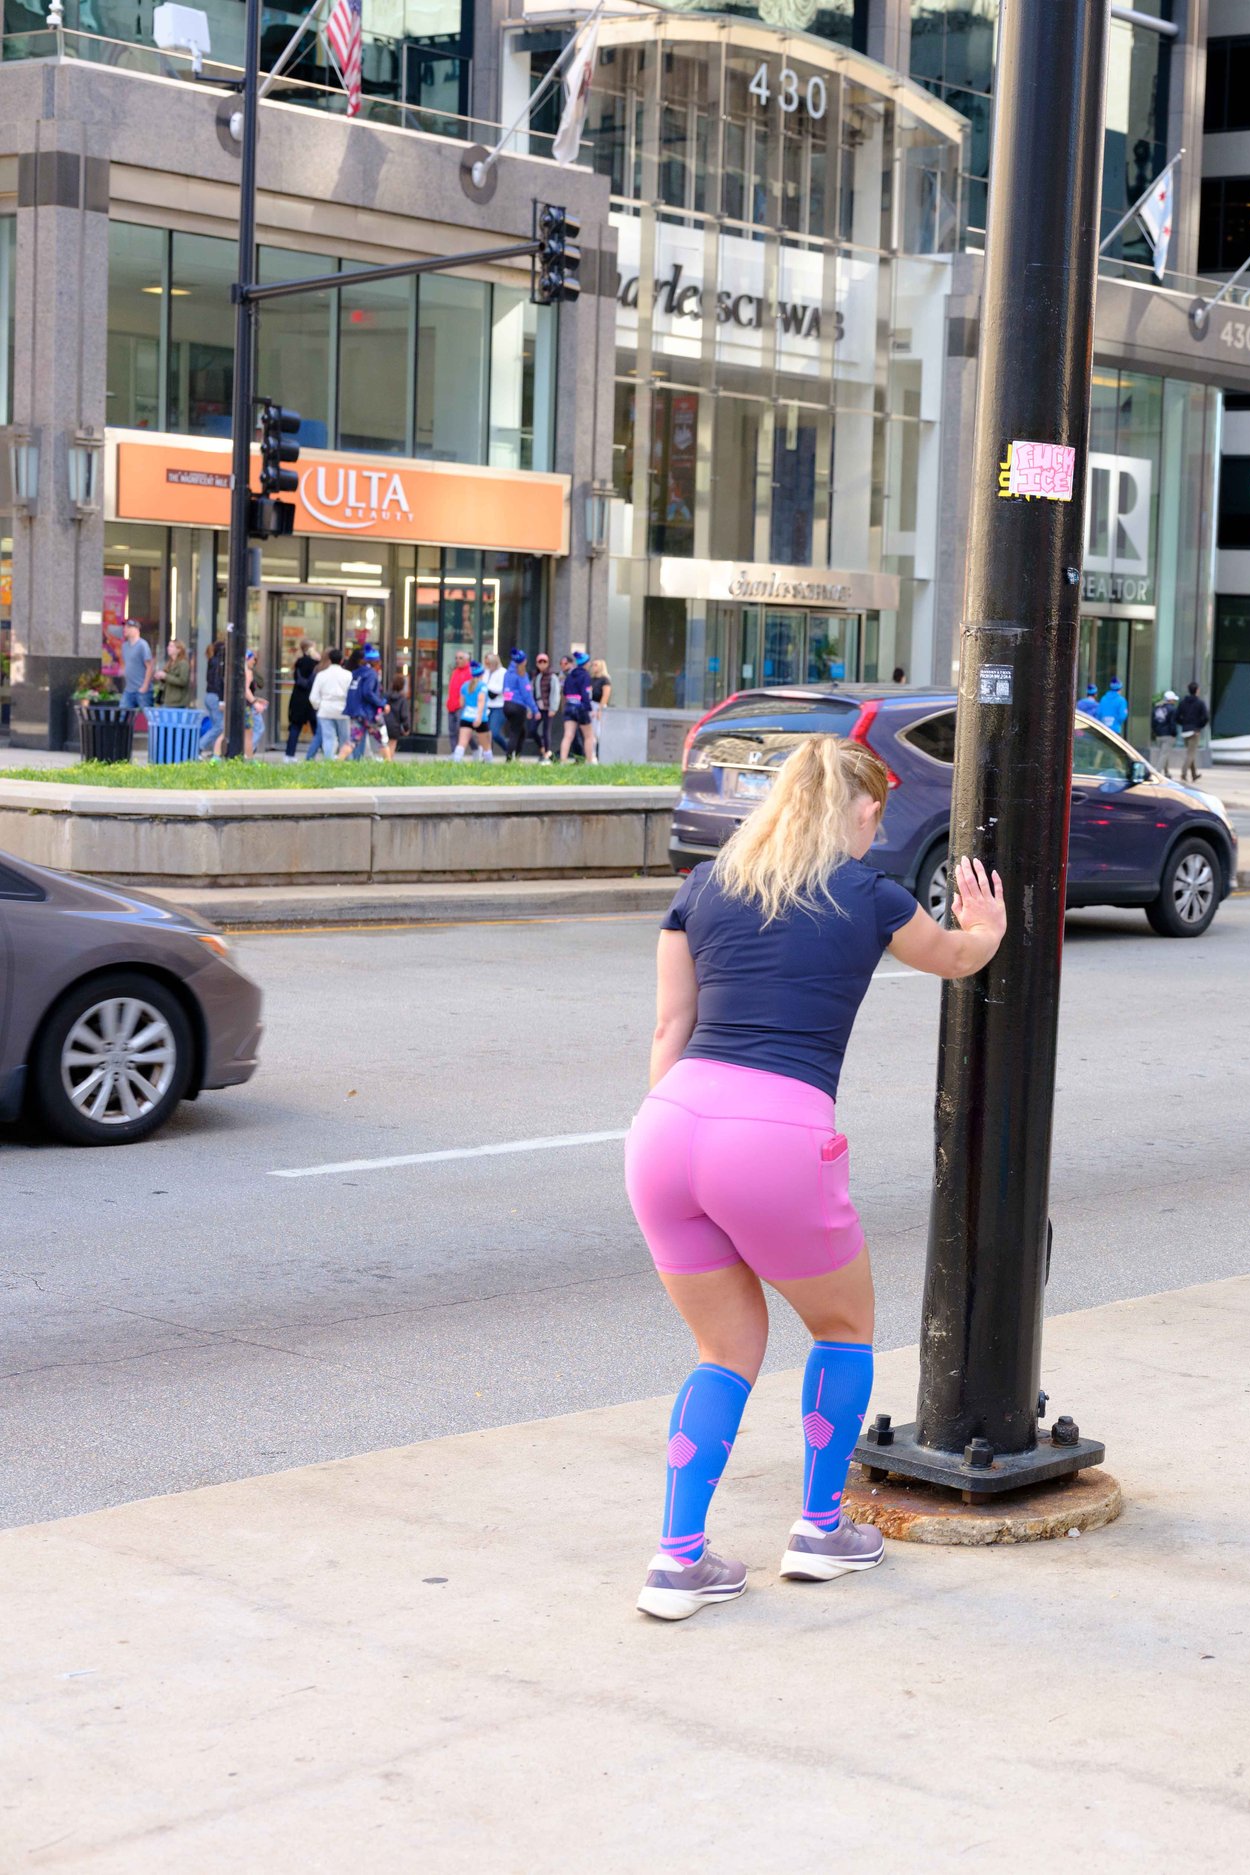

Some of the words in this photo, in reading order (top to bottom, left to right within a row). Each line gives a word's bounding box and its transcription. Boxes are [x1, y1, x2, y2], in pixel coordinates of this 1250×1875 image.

[748, 62, 827, 119] 430
[317, 467, 410, 512] ULTA
[1017, 467, 1071, 493] ICE
[344, 507, 414, 523] BEAUTY
